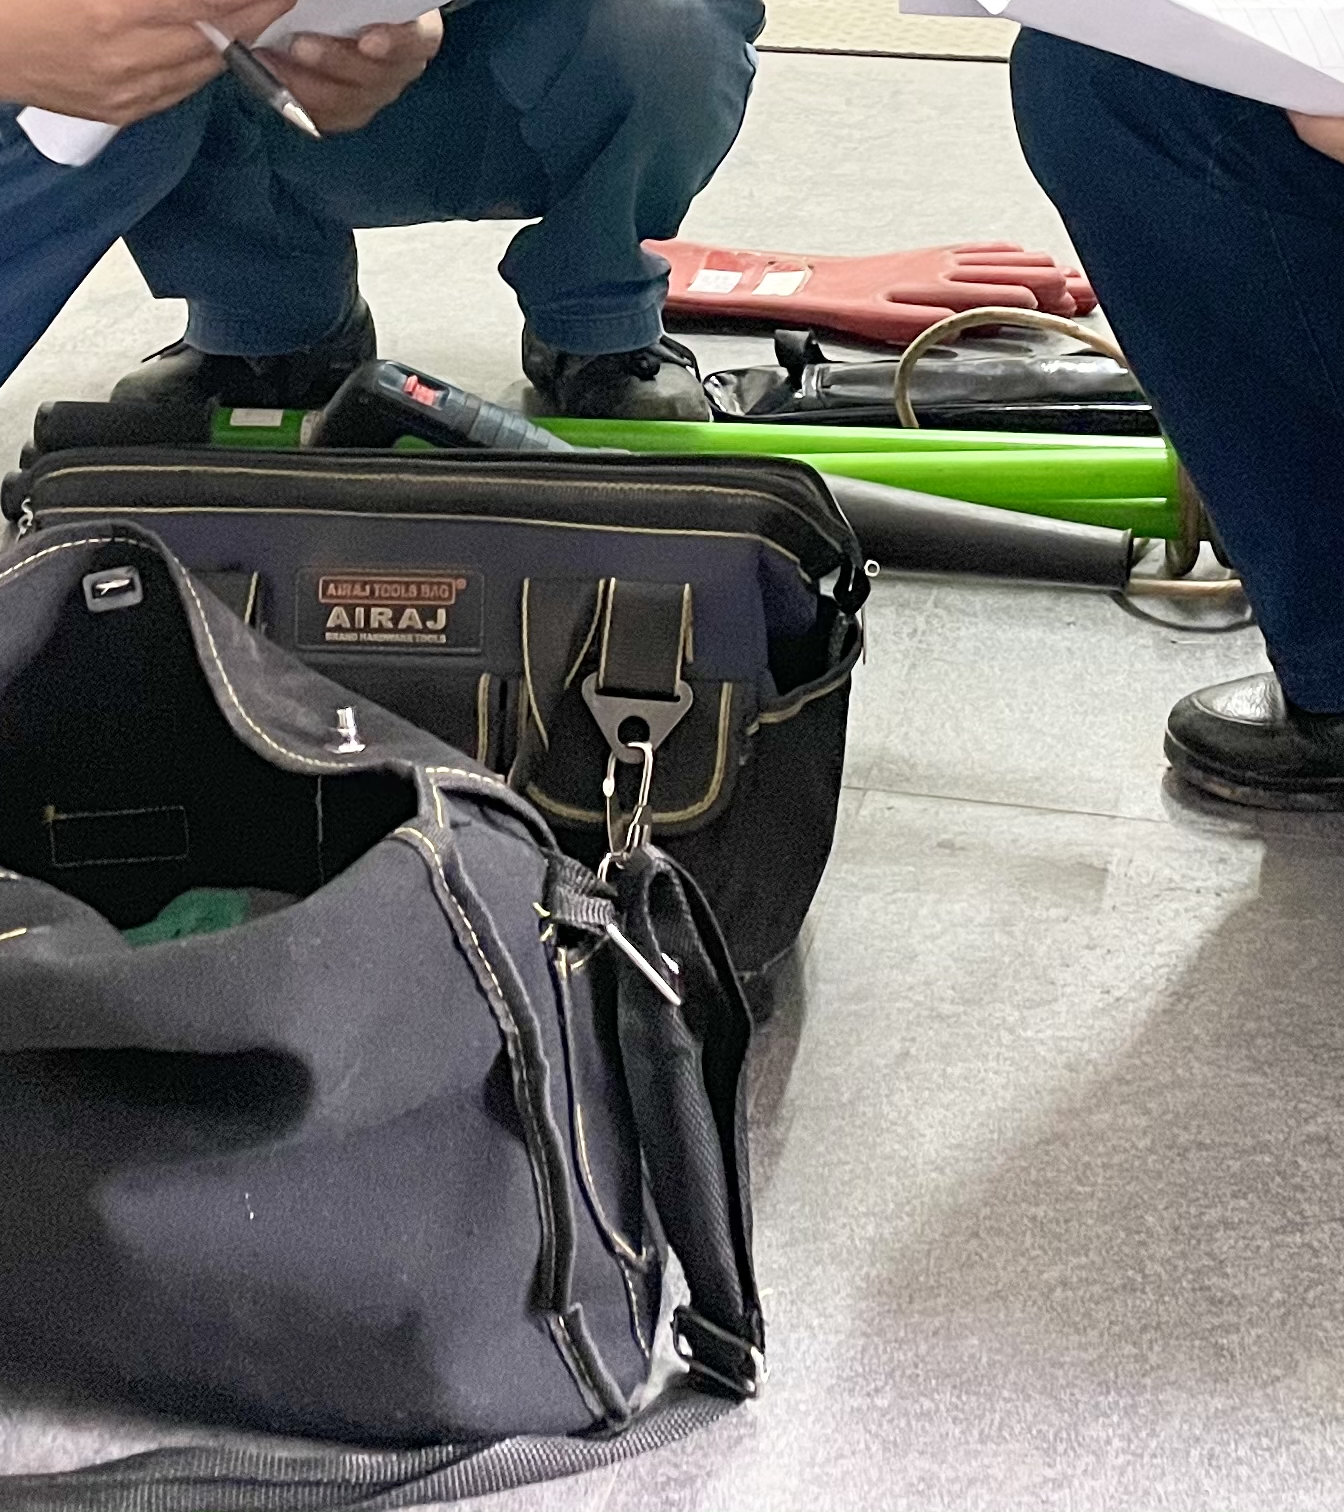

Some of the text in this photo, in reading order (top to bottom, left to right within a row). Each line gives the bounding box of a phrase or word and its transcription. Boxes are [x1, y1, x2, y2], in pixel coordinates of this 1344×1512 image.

[326, 582, 449, 599] AIRAJ TOOLS BAG
[326, 605, 447, 630] AIRAJ
